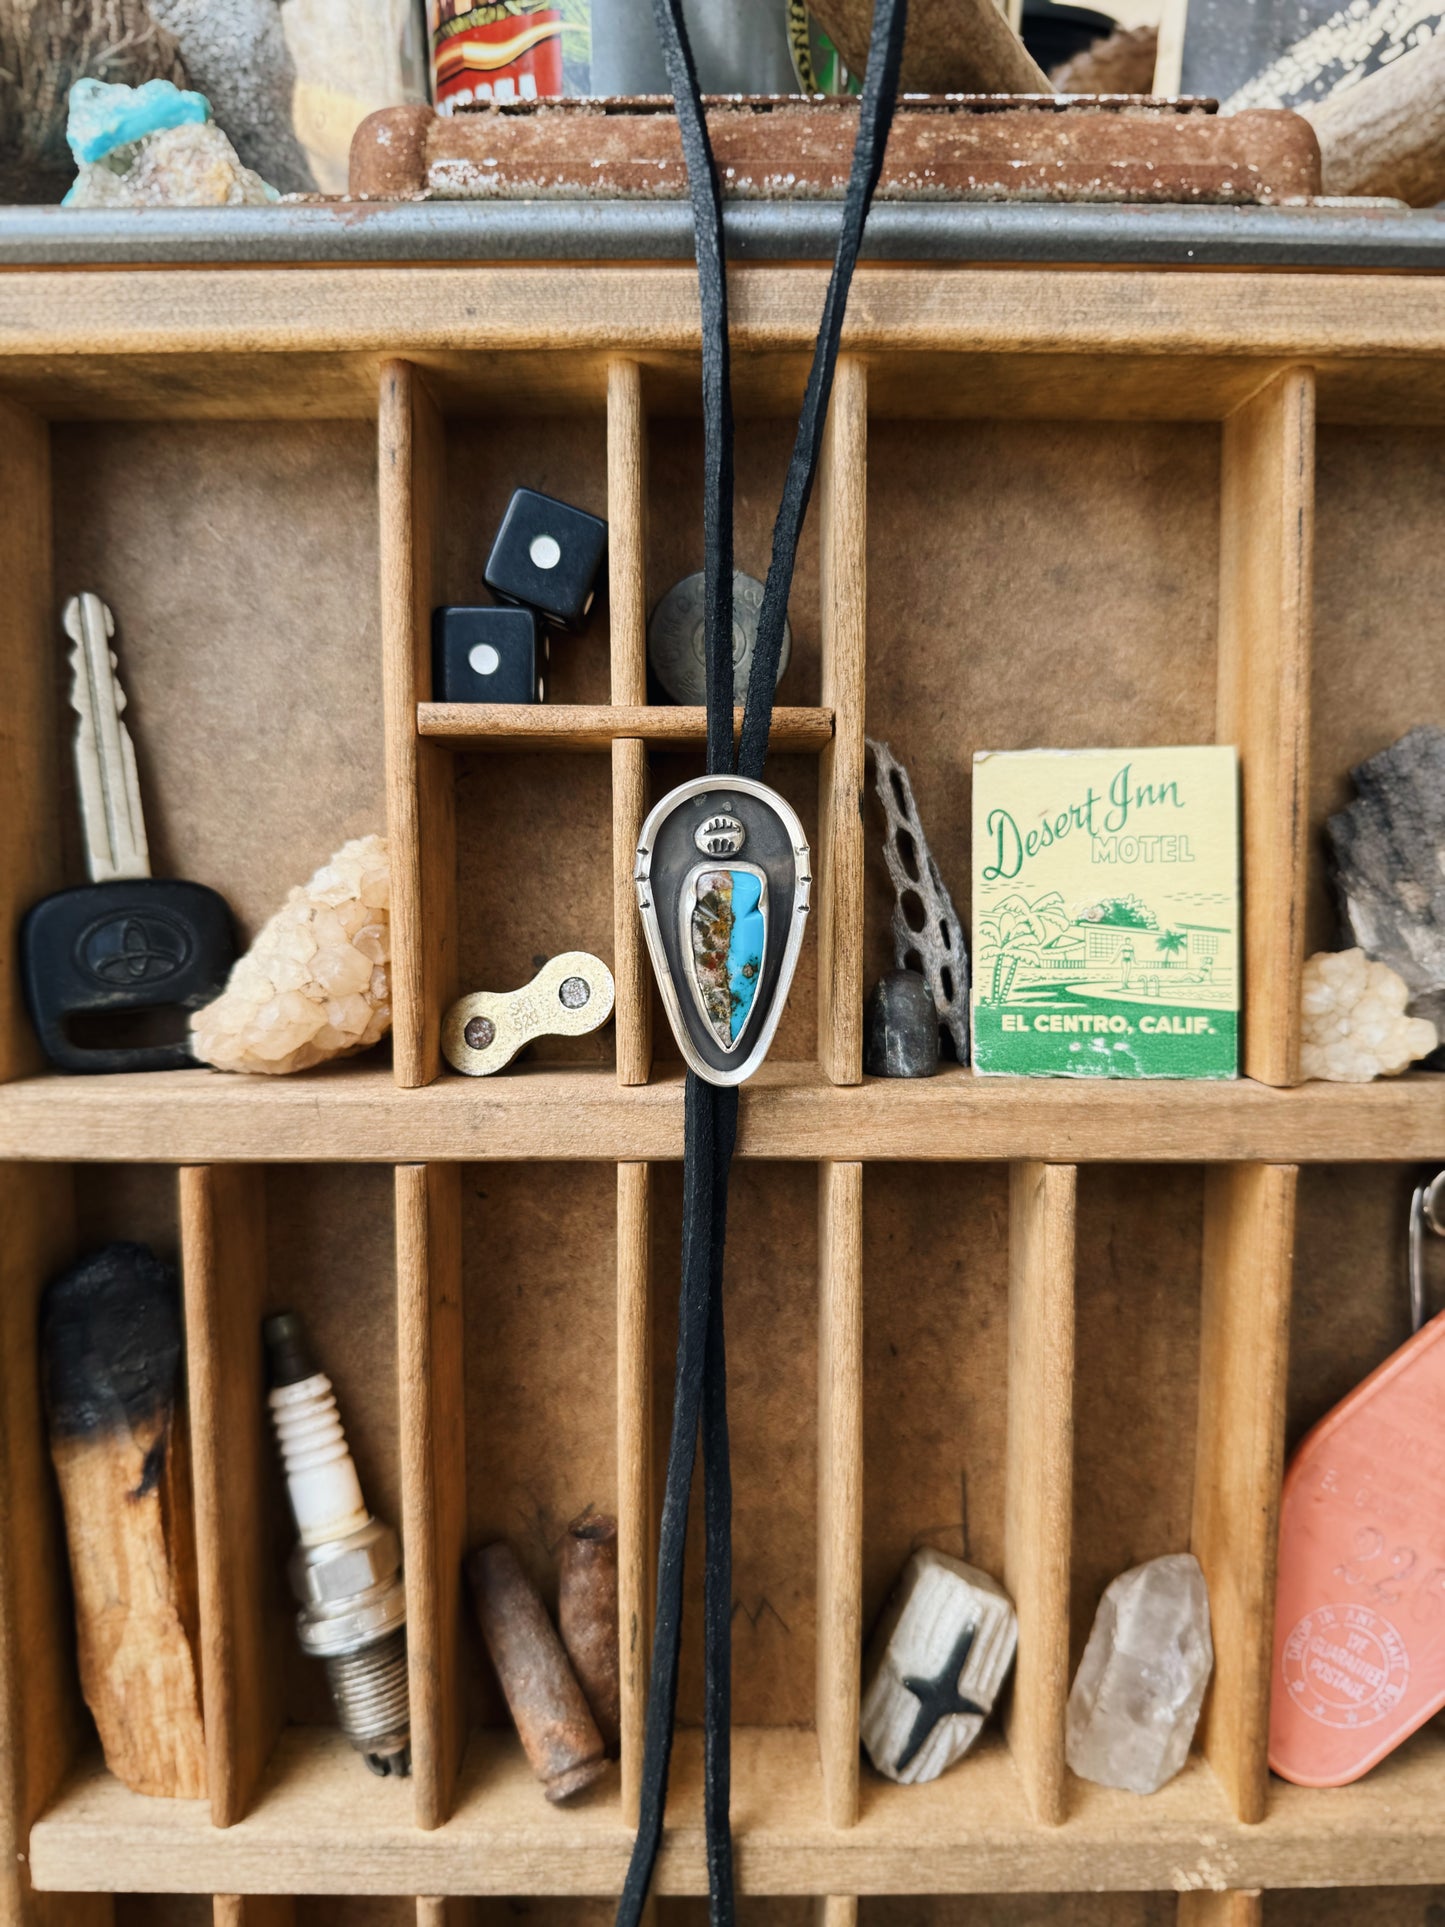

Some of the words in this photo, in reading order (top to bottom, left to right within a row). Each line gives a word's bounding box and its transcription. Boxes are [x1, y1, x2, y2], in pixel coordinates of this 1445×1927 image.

[982, 787, 1101, 881] Desert
[1103, 763, 1185, 833] Inn
[1091, 835, 1196, 865] MOTEL
[1001, 1014, 1030, 1032] EL
[1033, 1014, 1135, 1036] CENTRO,
[1138, 1015, 1216, 1035] CALIF.
[1286, 1619, 1313, 1661] DROP
[1318, 1609, 1336, 1625] IN
[1309, 1657, 1369, 1702] POSTAGE
